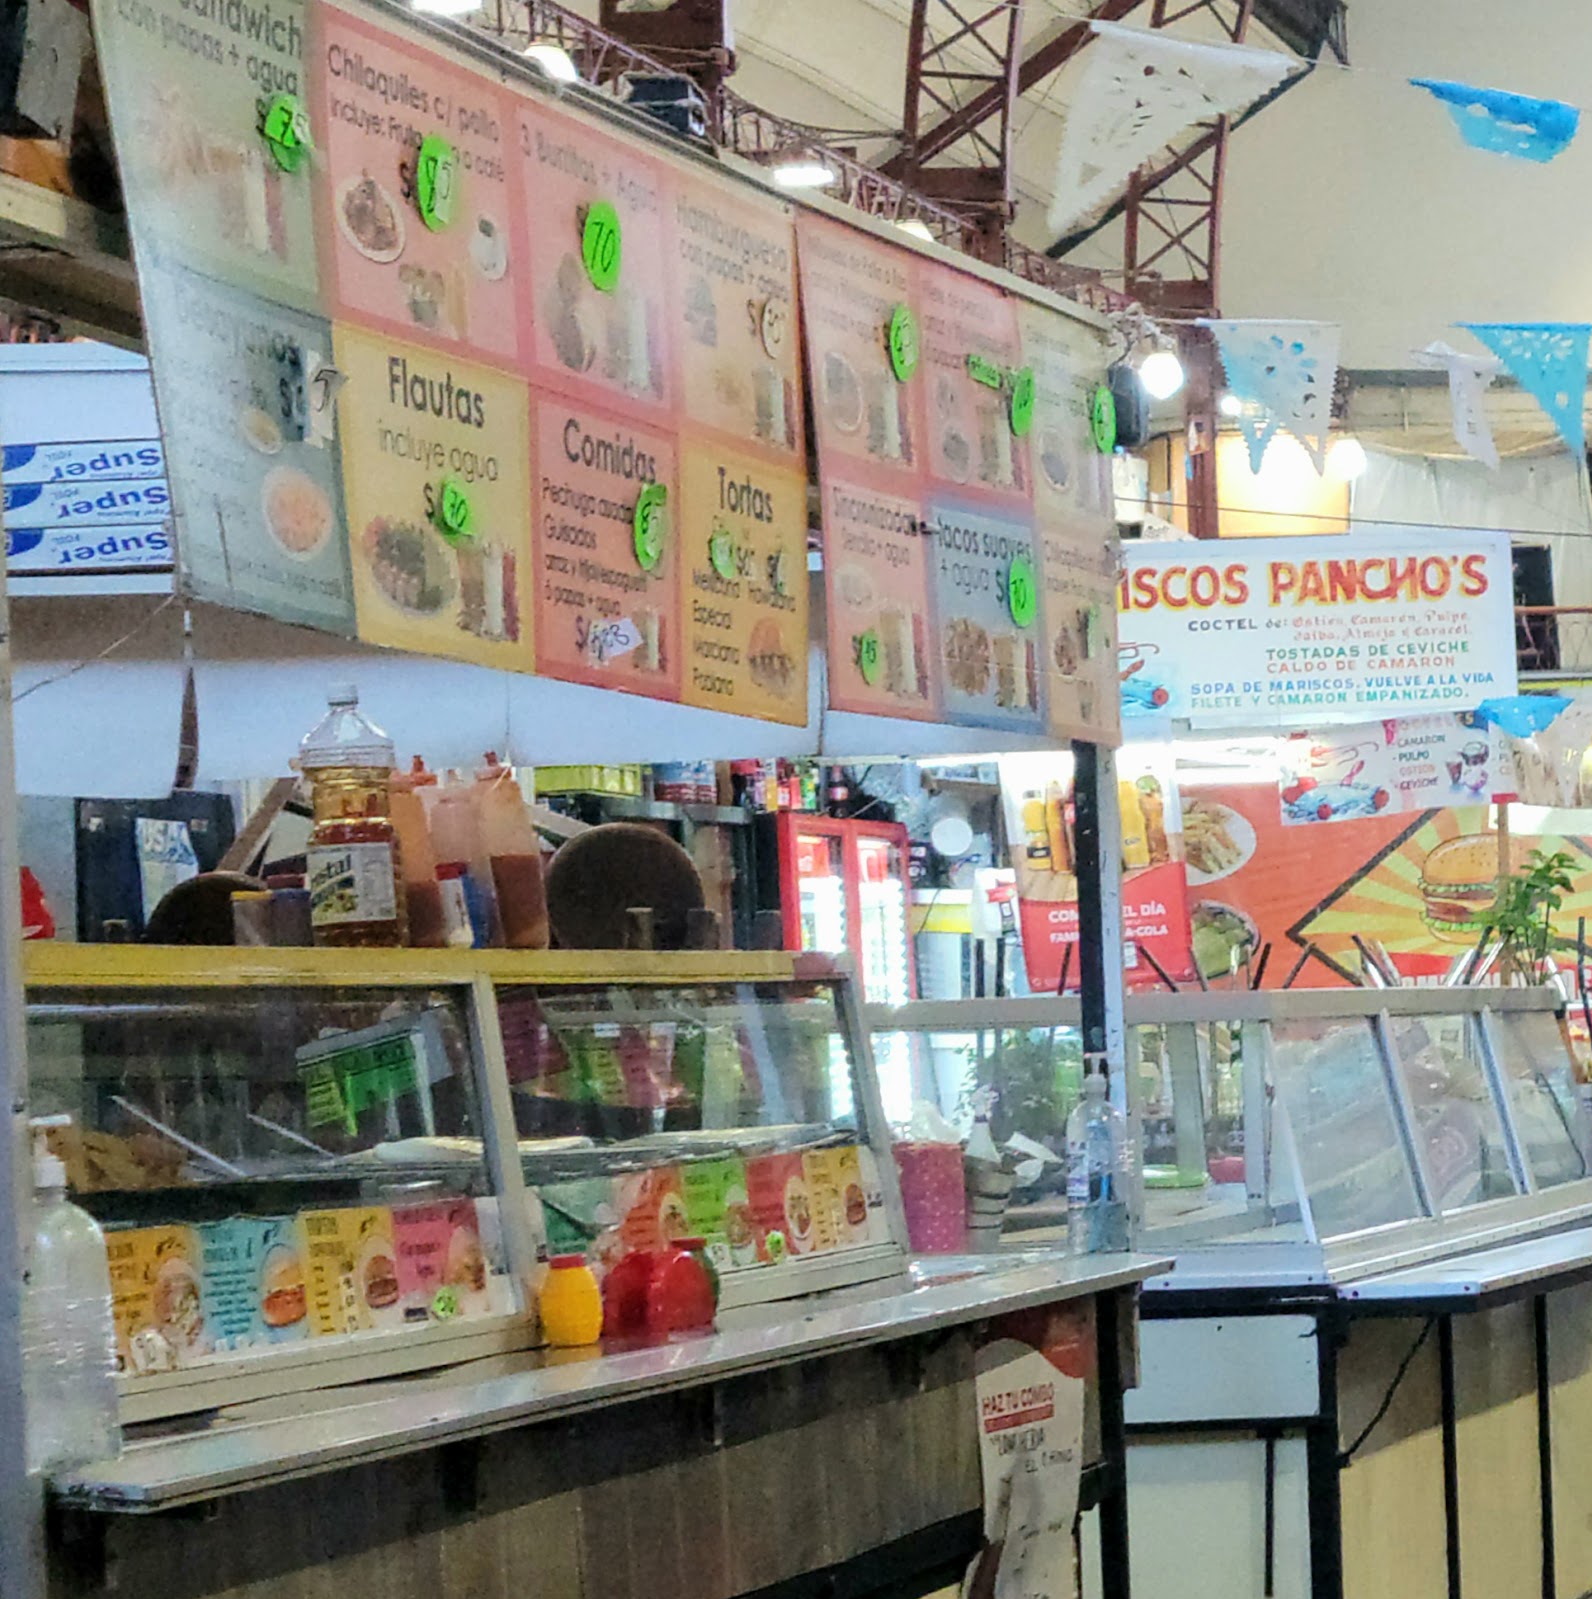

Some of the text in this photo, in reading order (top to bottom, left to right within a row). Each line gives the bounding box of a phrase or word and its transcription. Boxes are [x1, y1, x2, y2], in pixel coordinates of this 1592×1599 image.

[246, 54, 297, 95] agua
[328, 44, 429, 113] Chilaquiles
[591, 221, 615, 273] 70
[388, 356, 485, 429] Flautas
[50, 448, 161, 481] Super
[377, 419, 498, 483] incluye agua
[563, 418, 656, 484] Comidas
[58, 486, 169, 519] Super
[718, 465, 773, 523] Tortas
[58, 532, 169, 564] Super
[1119, 562, 1250, 611] ISCOS
[1270, 554, 1488, 606] PANCHO'S
[1188, 617, 1258, 632] COCTEL
[1266, 640, 1470, 661] TOSTADAS DE CEVICHE
[1267, 656, 1455, 675] CALDO DE CAMARON
[1191, 682, 1235, 696] SOPA
[1243, 680, 1262, 694] DE
[1365, 675, 1422, 689] VUELVE
[1427, 673, 1435, 685] A
[1439, 673, 1457, 685] LA
[1462, 671, 1494, 684] VIDA
[1191, 695, 1242, 709] FILETE
[1251, 694, 1260, 706] Y
[1267, 692, 1347, 706] CAMARON
[1048, 909, 1079, 924] COM
[1140, 901, 1167, 916] DÍA
[1124, 925, 1168, 938] A-COLA
